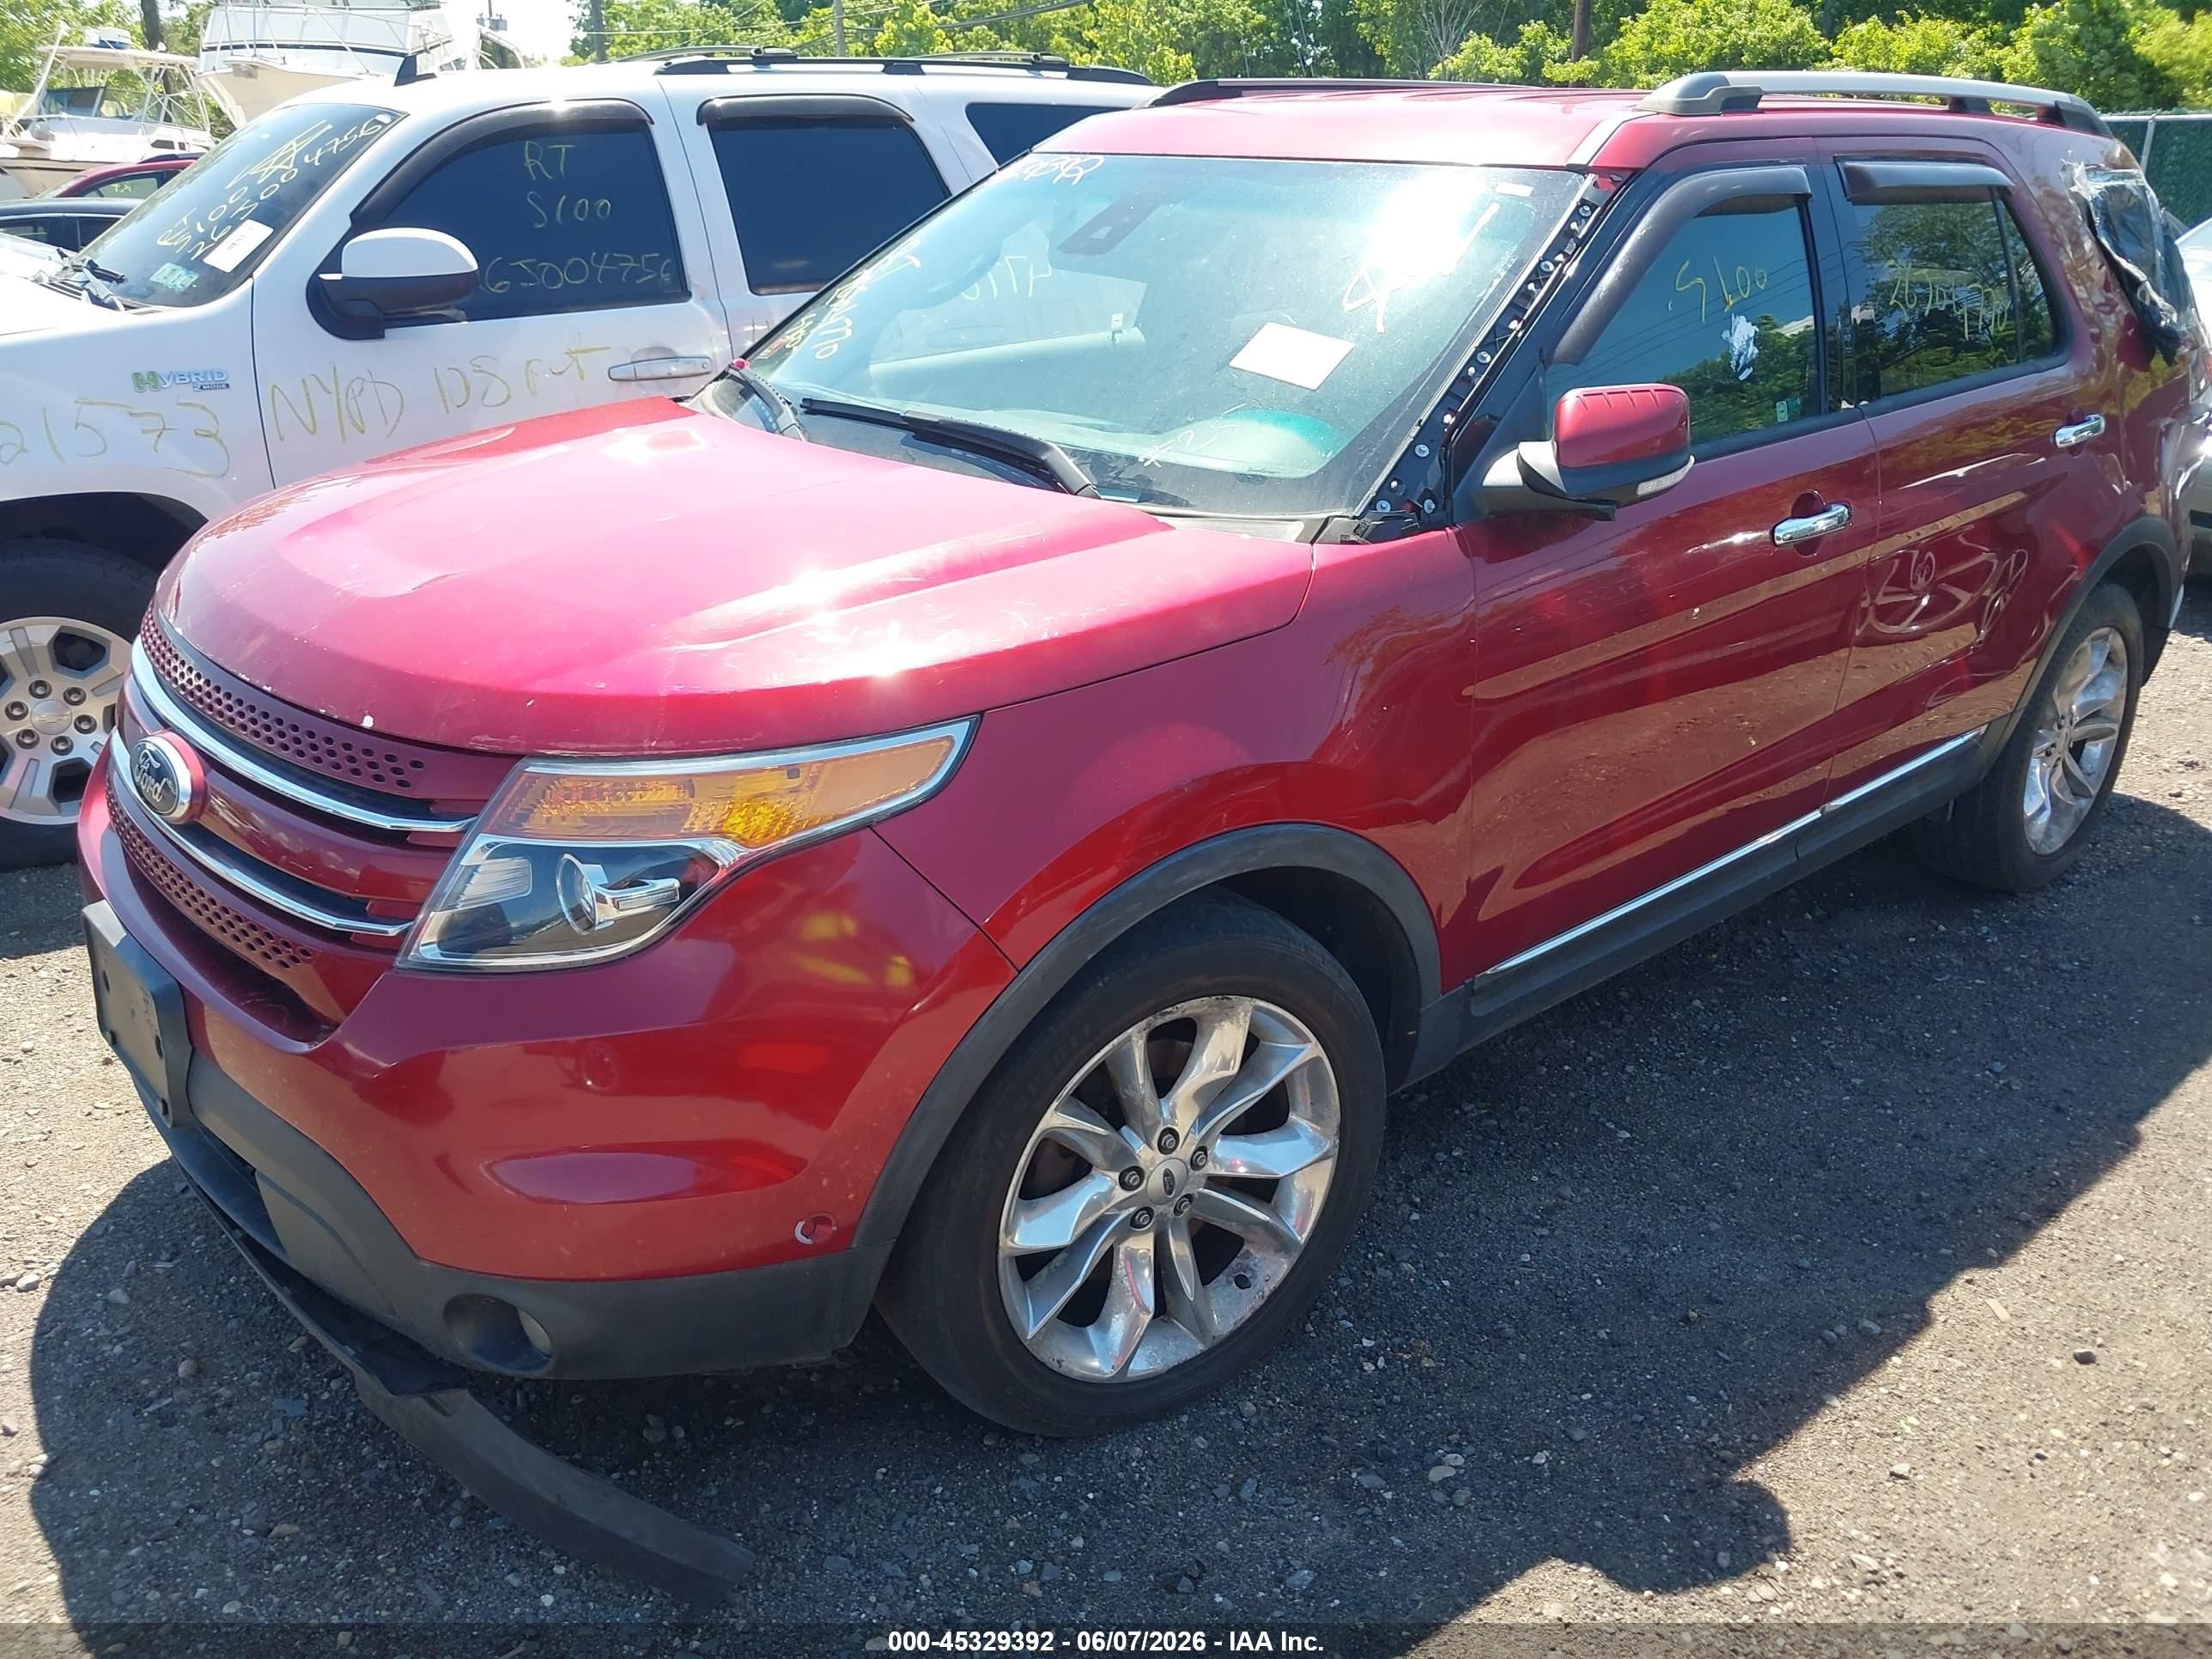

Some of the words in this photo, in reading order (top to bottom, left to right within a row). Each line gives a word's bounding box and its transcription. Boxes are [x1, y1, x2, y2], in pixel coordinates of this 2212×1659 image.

[525, 140, 576, 180] RT
[526, 191, 611, 228] S100
[135, 749, 168, 803] Ford
